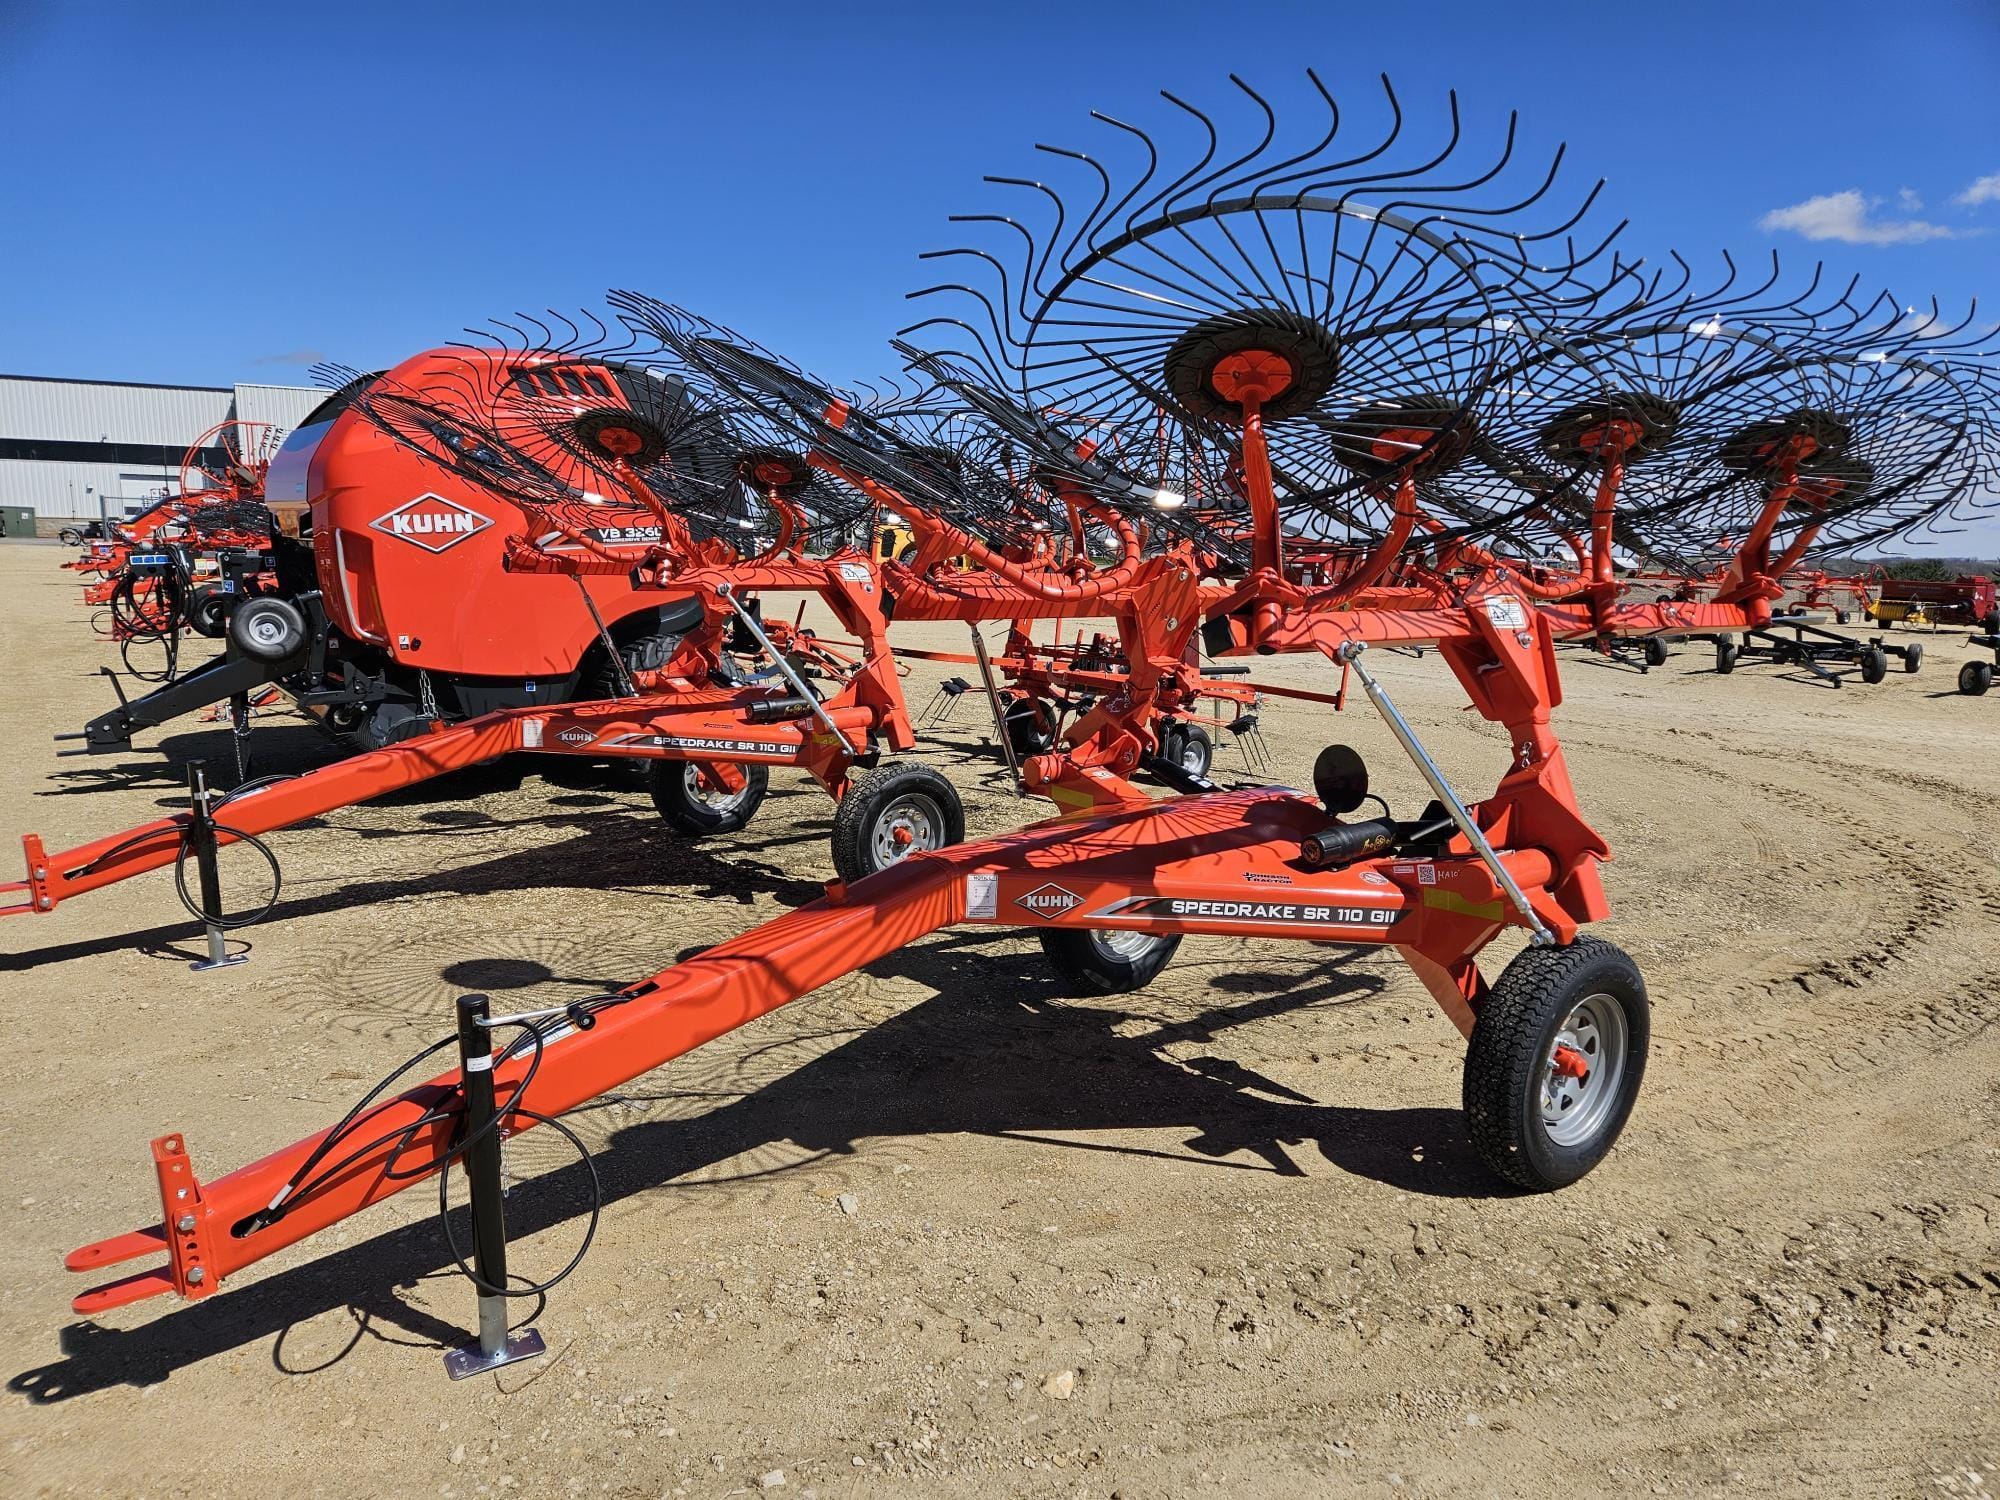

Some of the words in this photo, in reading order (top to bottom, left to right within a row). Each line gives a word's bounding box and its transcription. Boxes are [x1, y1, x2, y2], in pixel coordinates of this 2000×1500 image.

[392, 513, 474, 534] KUHN
[598, 528, 620, 539] VB
[561, 733, 592, 742] KUHN
[653, 736, 733, 749] SPEEDRAKE
[737, 741, 755, 751] SR
[759, 743, 776, 752] 110
[780, 745, 796, 753] GII
[1026, 895, 1074, 907] KUHN
[1171, 900, 1297, 919] SPEEDRAKE
[1303, 907, 1330, 920] SR
[1338, 909, 1363, 922] 110
[1370, 910, 1396, 923] GII
